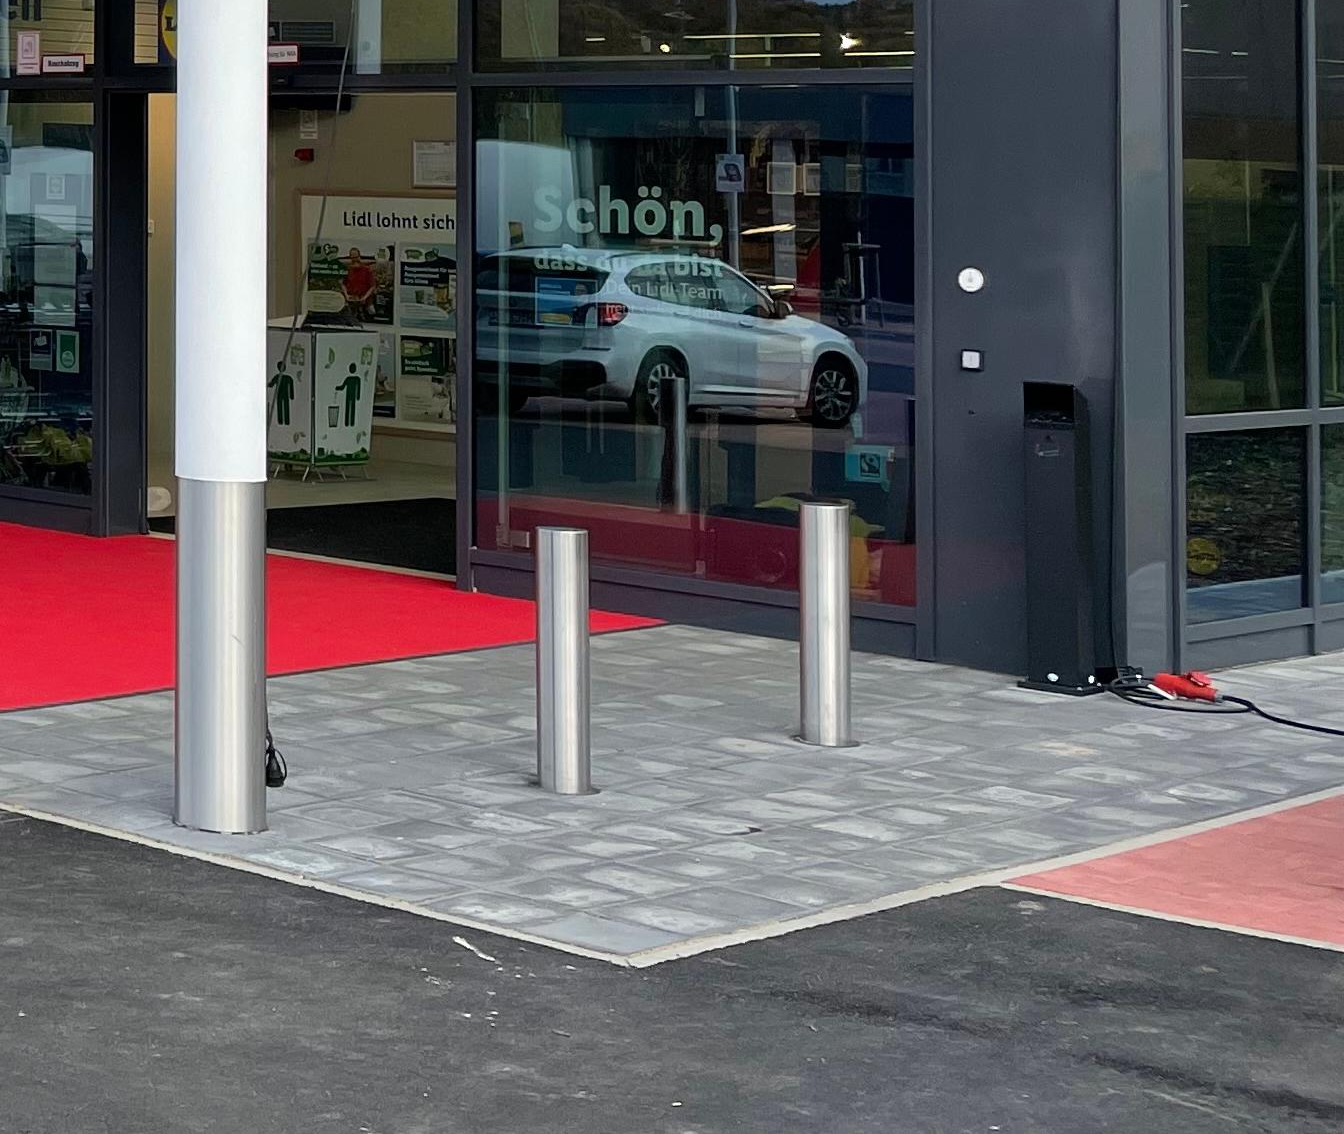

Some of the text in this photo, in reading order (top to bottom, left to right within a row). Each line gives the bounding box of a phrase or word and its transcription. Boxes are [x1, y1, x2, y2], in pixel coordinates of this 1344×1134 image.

[343, 210, 455, 230] Lidl lohnt sich
[533, 184, 724, 246] Schön,
[534, 248, 588, 272] dass
[674, 251, 724, 278] bist
[646, 280, 723, 300] Lidl-Team
